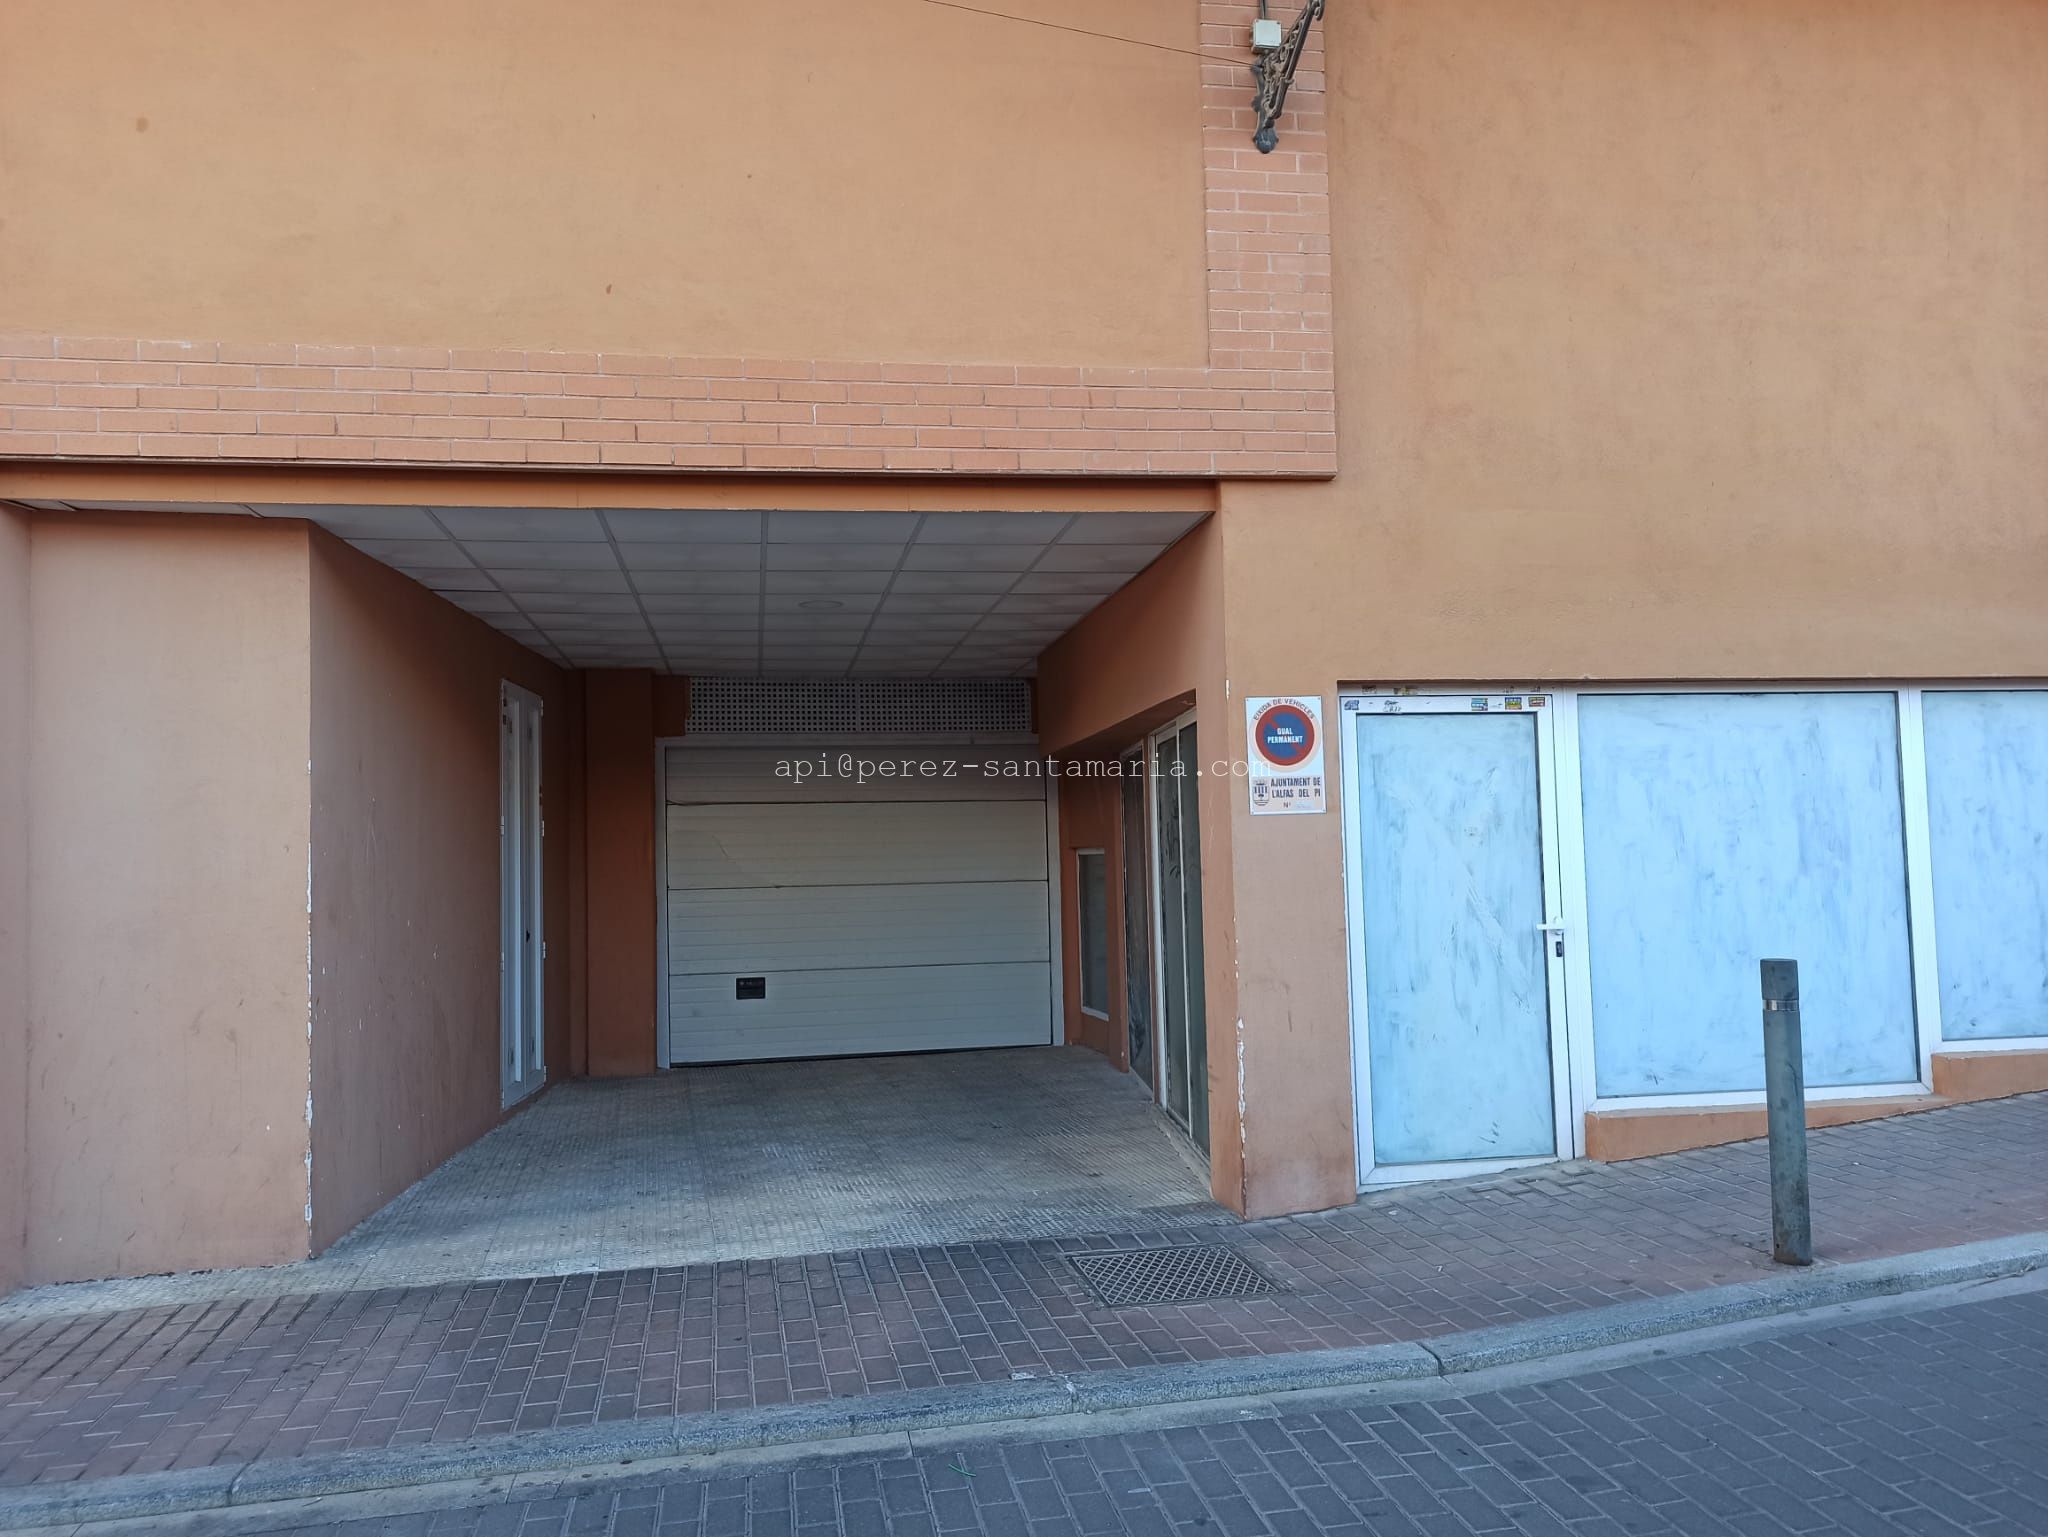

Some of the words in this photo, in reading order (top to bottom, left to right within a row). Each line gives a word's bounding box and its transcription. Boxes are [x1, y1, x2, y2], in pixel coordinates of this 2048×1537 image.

[1272, 698, 1282, 706] DE
[1284, 697, 1315, 719] VEHICLES
[1267, 735, 1304, 744] PERMANENT
[1270, 777, 1311, 788] AJUNTAMENT
[1312, 776, 1321, 786] DE
[1298, 788, 1310, 798] DEL
